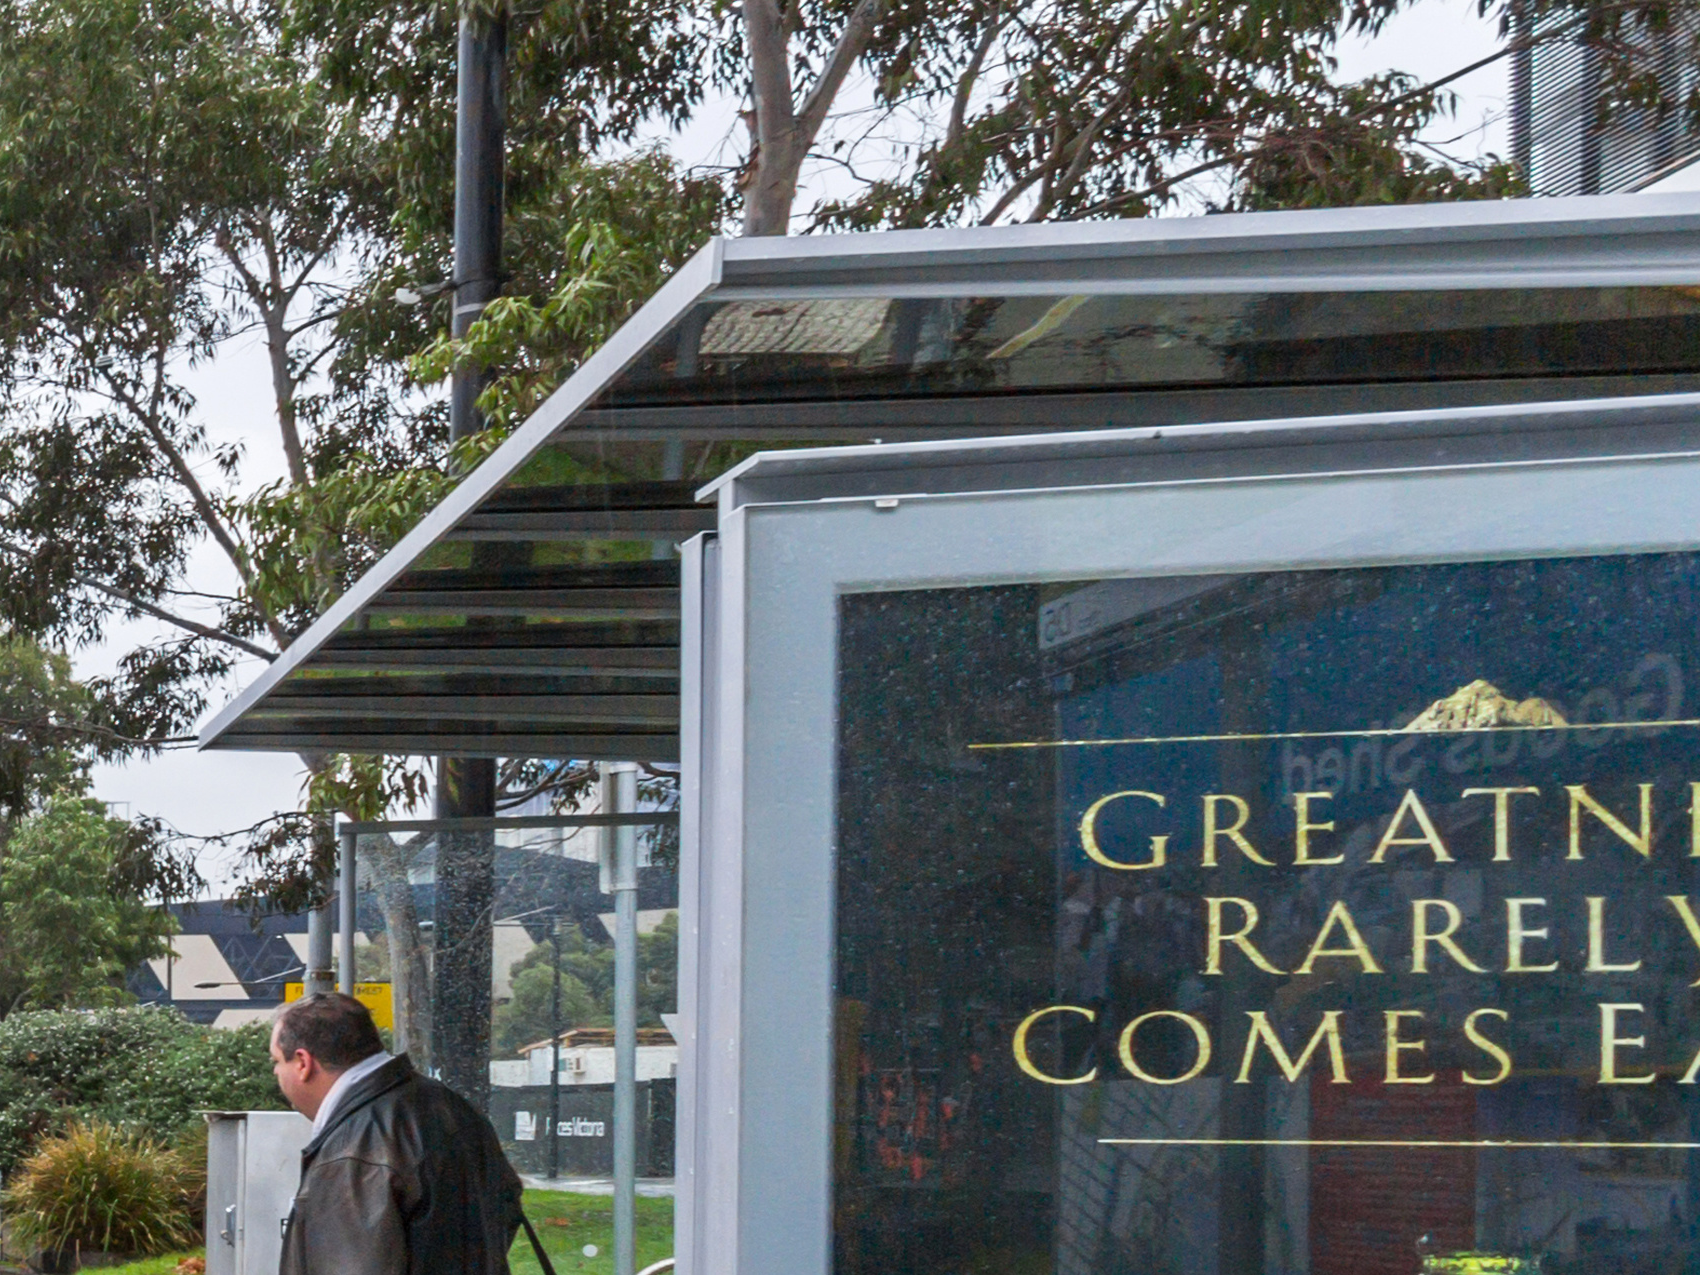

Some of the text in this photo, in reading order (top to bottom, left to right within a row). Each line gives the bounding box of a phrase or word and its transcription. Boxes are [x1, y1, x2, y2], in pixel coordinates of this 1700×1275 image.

[1078, 781, 1700, 871] GREATN
[1011, 1002, 1700, 1086] COMES E
